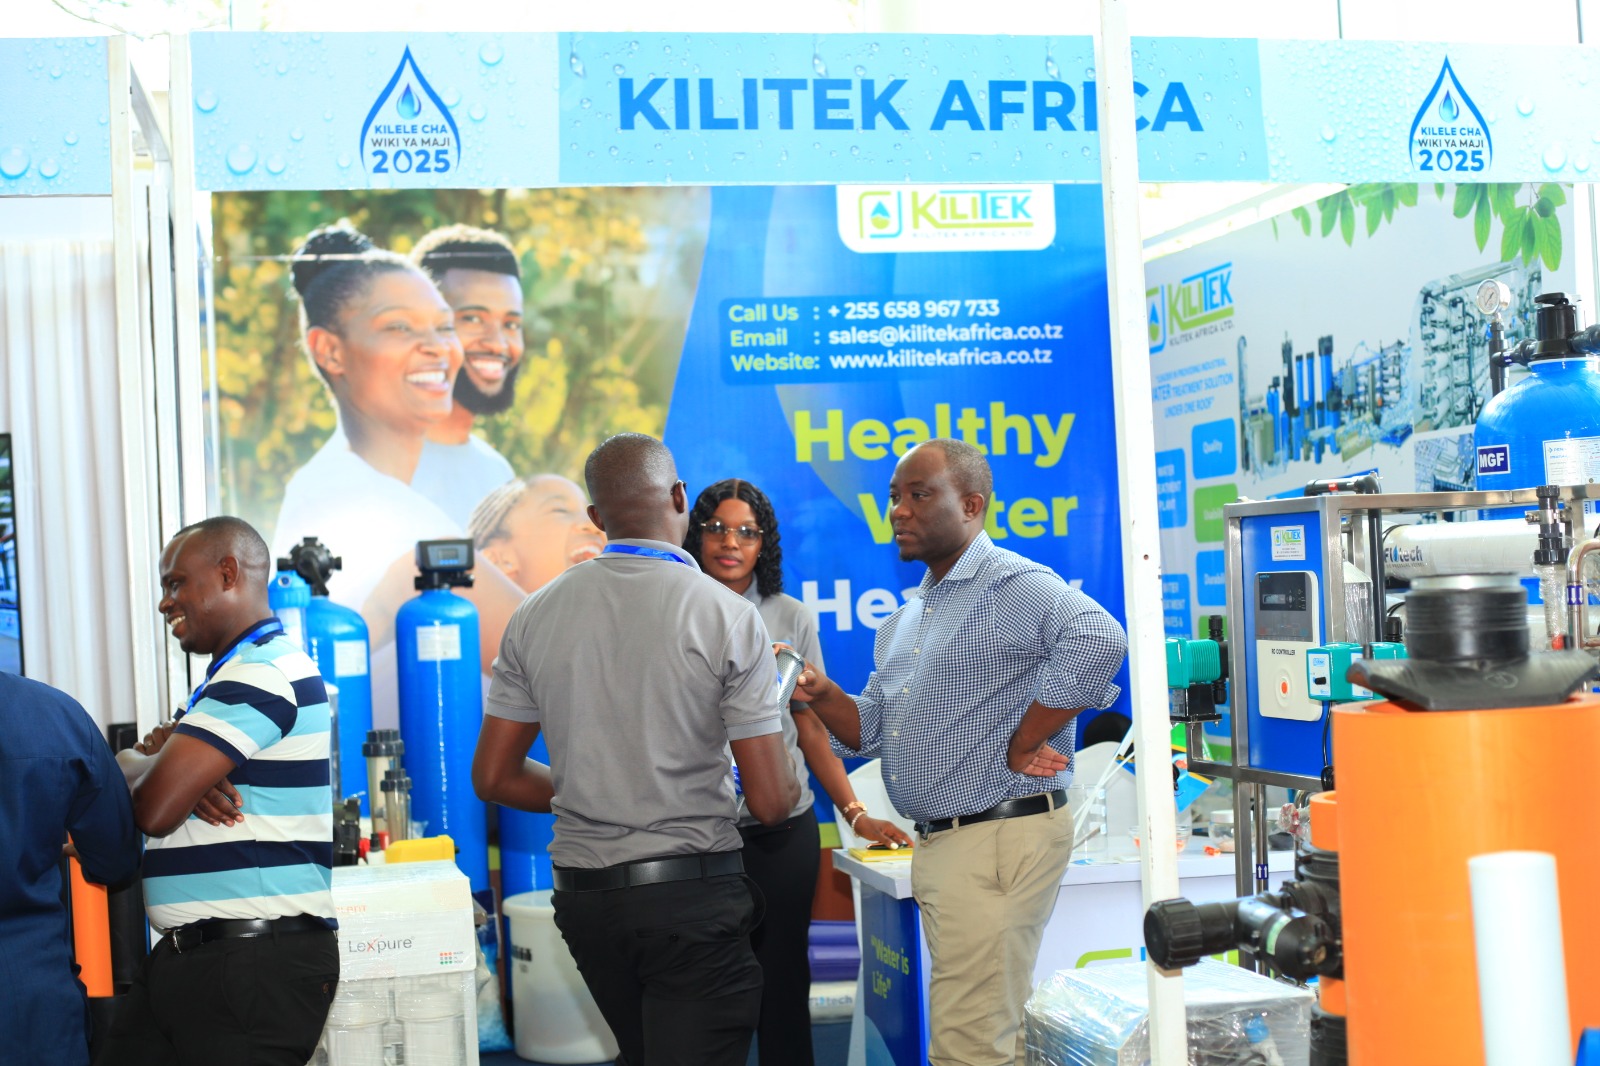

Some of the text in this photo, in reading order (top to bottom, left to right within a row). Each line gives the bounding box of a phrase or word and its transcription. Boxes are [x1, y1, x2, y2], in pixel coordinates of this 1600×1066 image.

[618, 77, 911, 131] KILITEK
[374, 124, 448, 134] KILELE CHA
[1421, 126, 1481, 136] KILELE CHA
[371, 137, 450, 147] WIKI YA MAJI
[1418, 138, 1484, 148] WIKI YA MAJI
[371, 149, 451, 173] 2025
[1418, 149, 1485, 172] 2025
[728, 303, 768, 322] Call
[772, 303, 799, 321] Us
[843, 301, 880, 320] 255
[883, 301, 922, 319] 658
[924, 299, 961, 318] 967
[964, 299, 1000, 317] 733
[731, 327, 788, 347] Email
[828, 323, 1063, 348] sales@kilitekafrica.co.tz
[829, 348, 1053, 369] www.kilitekafrica.co.tz
[794, 401, 1076, 468] Healthy
[1480, 452, 1505, 468] MGF
[348, 935, 413, 954] Lexpure
[901, 947, 909, 975] is
